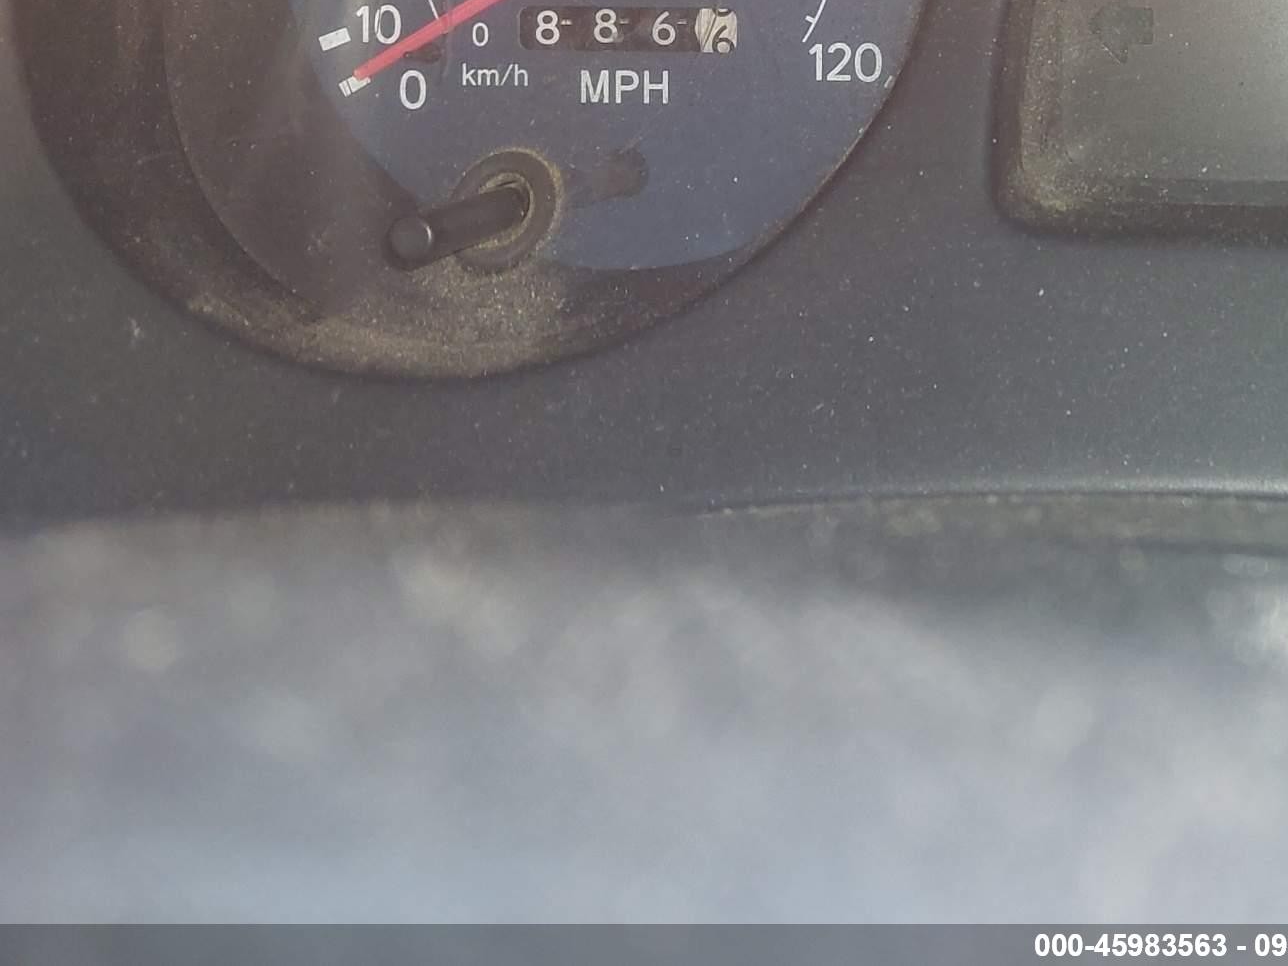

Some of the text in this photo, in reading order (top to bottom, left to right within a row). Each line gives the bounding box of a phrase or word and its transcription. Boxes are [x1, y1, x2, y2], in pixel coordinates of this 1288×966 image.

[356, 5, 401, 43] 10
[473, 23, 488, 46] 0
[462, 63, 528, 86] km/h
[809, 43, 882, 82] 120
[400, 70, 426, 109] 0
[581, 70, 668, 103] MPH
